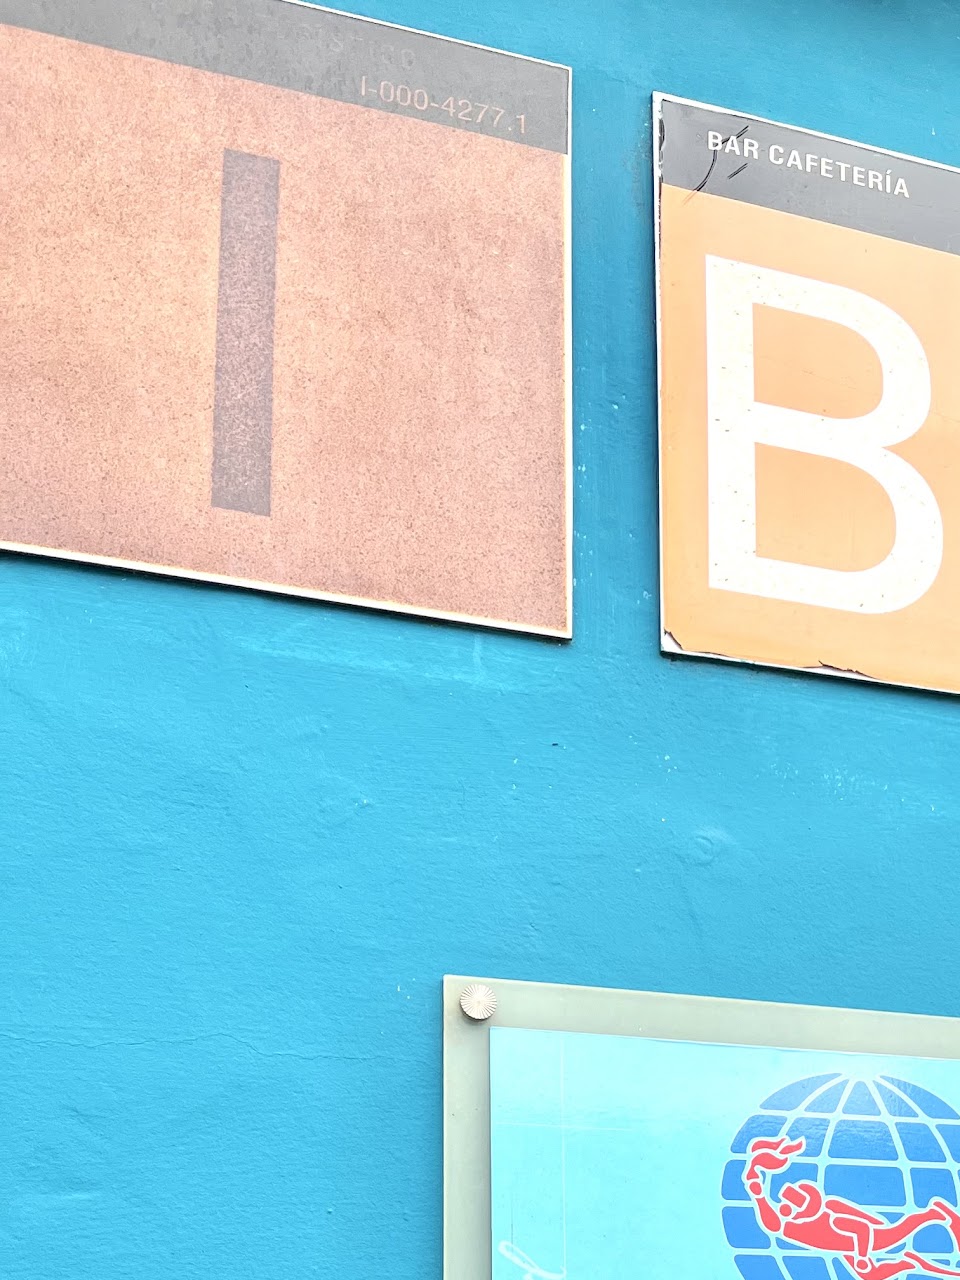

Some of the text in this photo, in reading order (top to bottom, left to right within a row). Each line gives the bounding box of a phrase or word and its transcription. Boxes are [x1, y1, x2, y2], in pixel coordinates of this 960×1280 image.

[360, 75, 529, 134] I-000-4277.1
[707, 130, 910, 198] BAR CAFETERÍA
